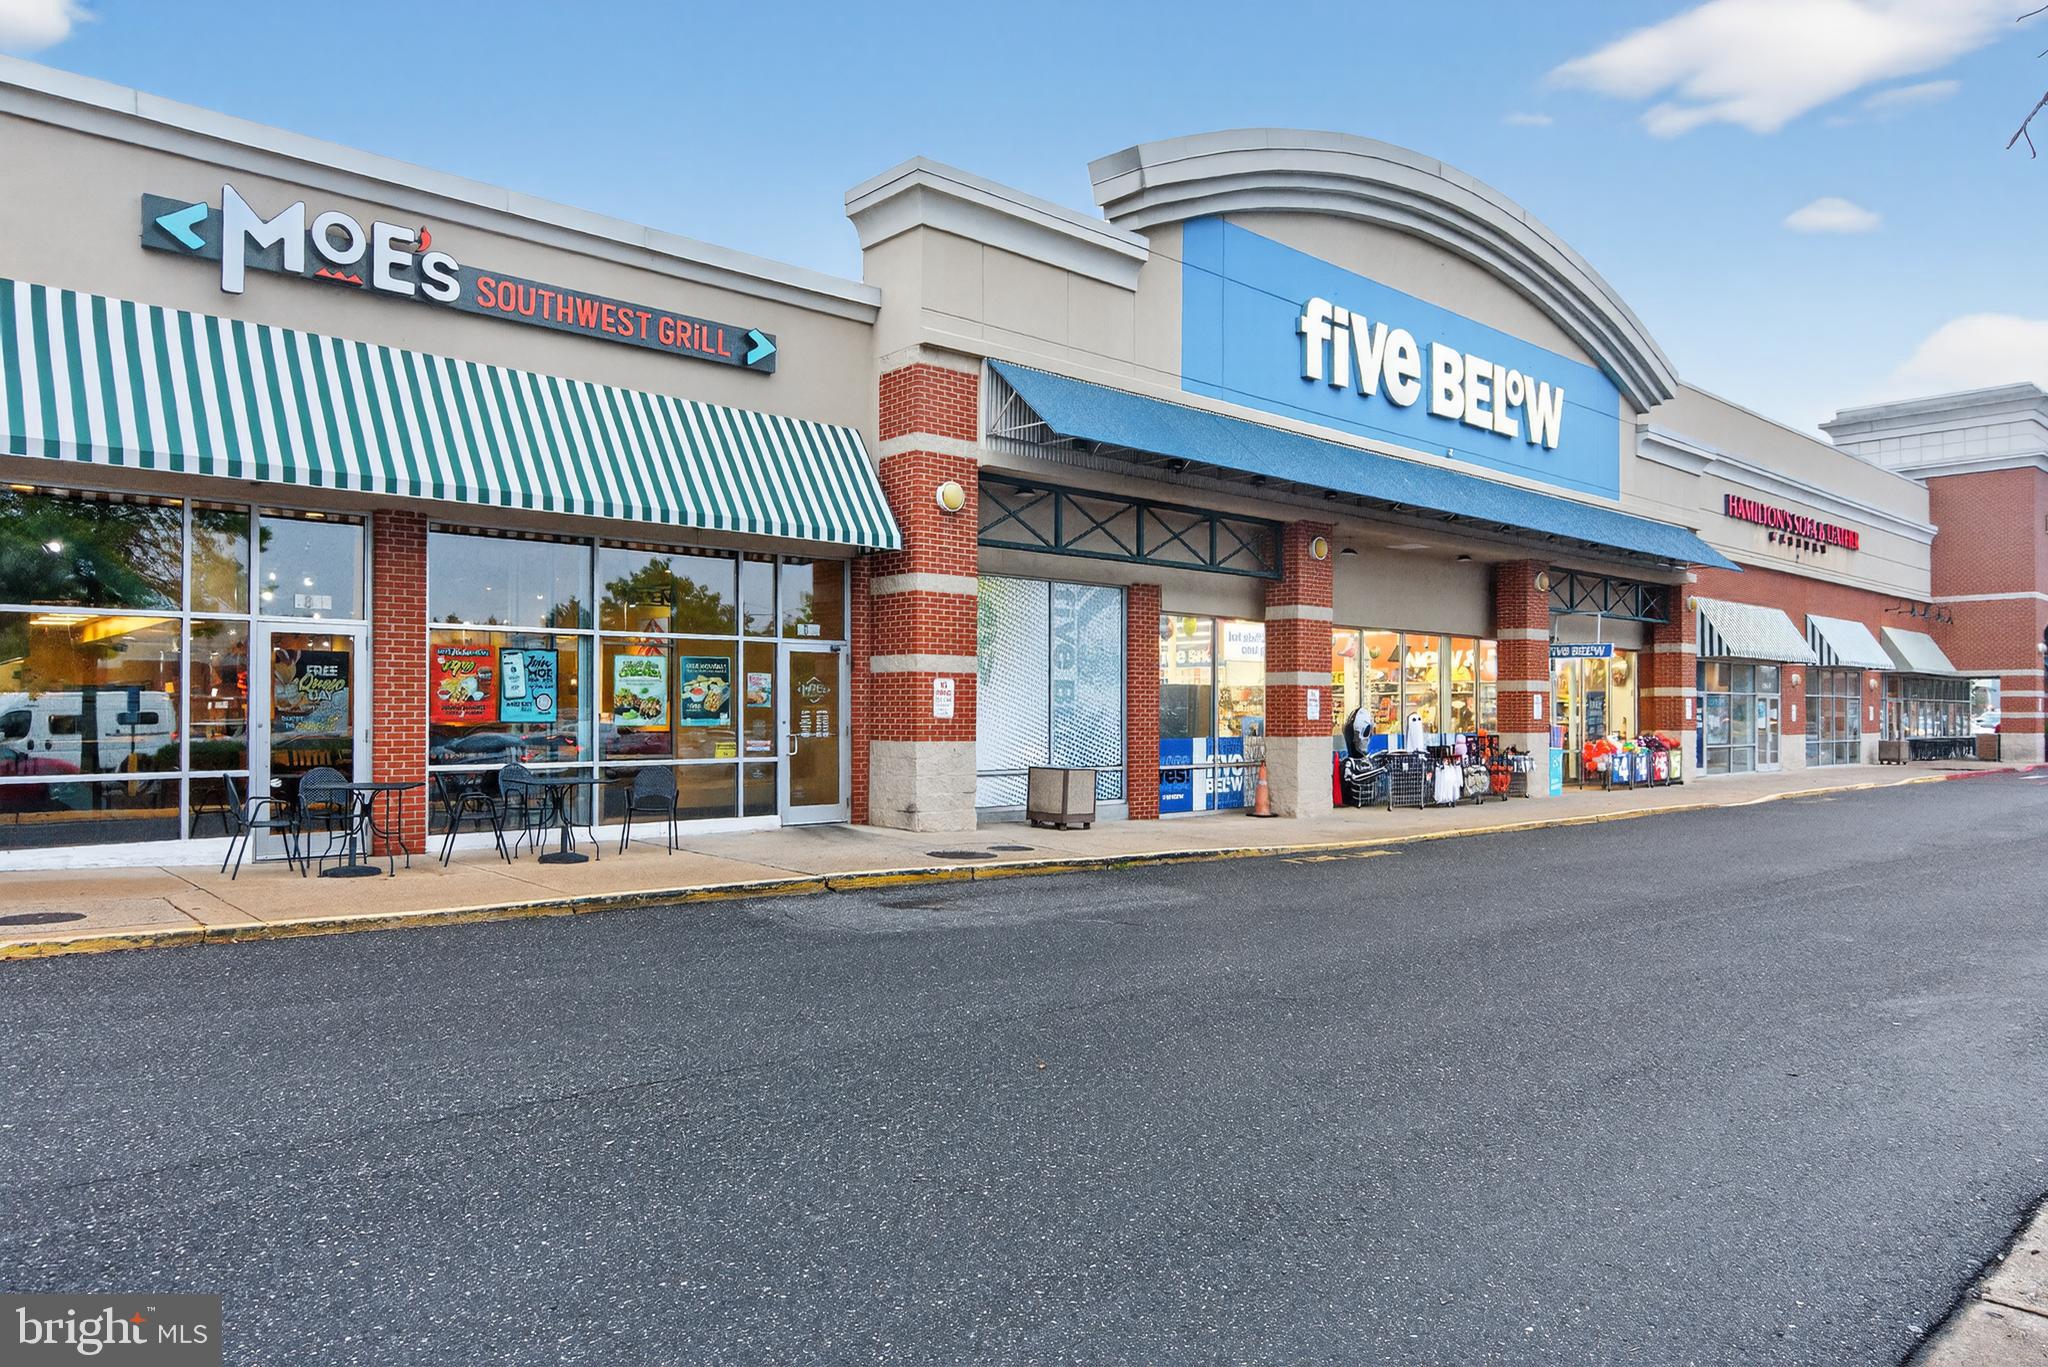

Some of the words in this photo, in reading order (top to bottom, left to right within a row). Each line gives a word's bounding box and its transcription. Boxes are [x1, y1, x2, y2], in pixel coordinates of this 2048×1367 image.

[476, 276, 651, 340] SOUTHWEST
[1725, 494, 1793, 532] HAMILTON'S
[306, 665, 339, 676] FREE
